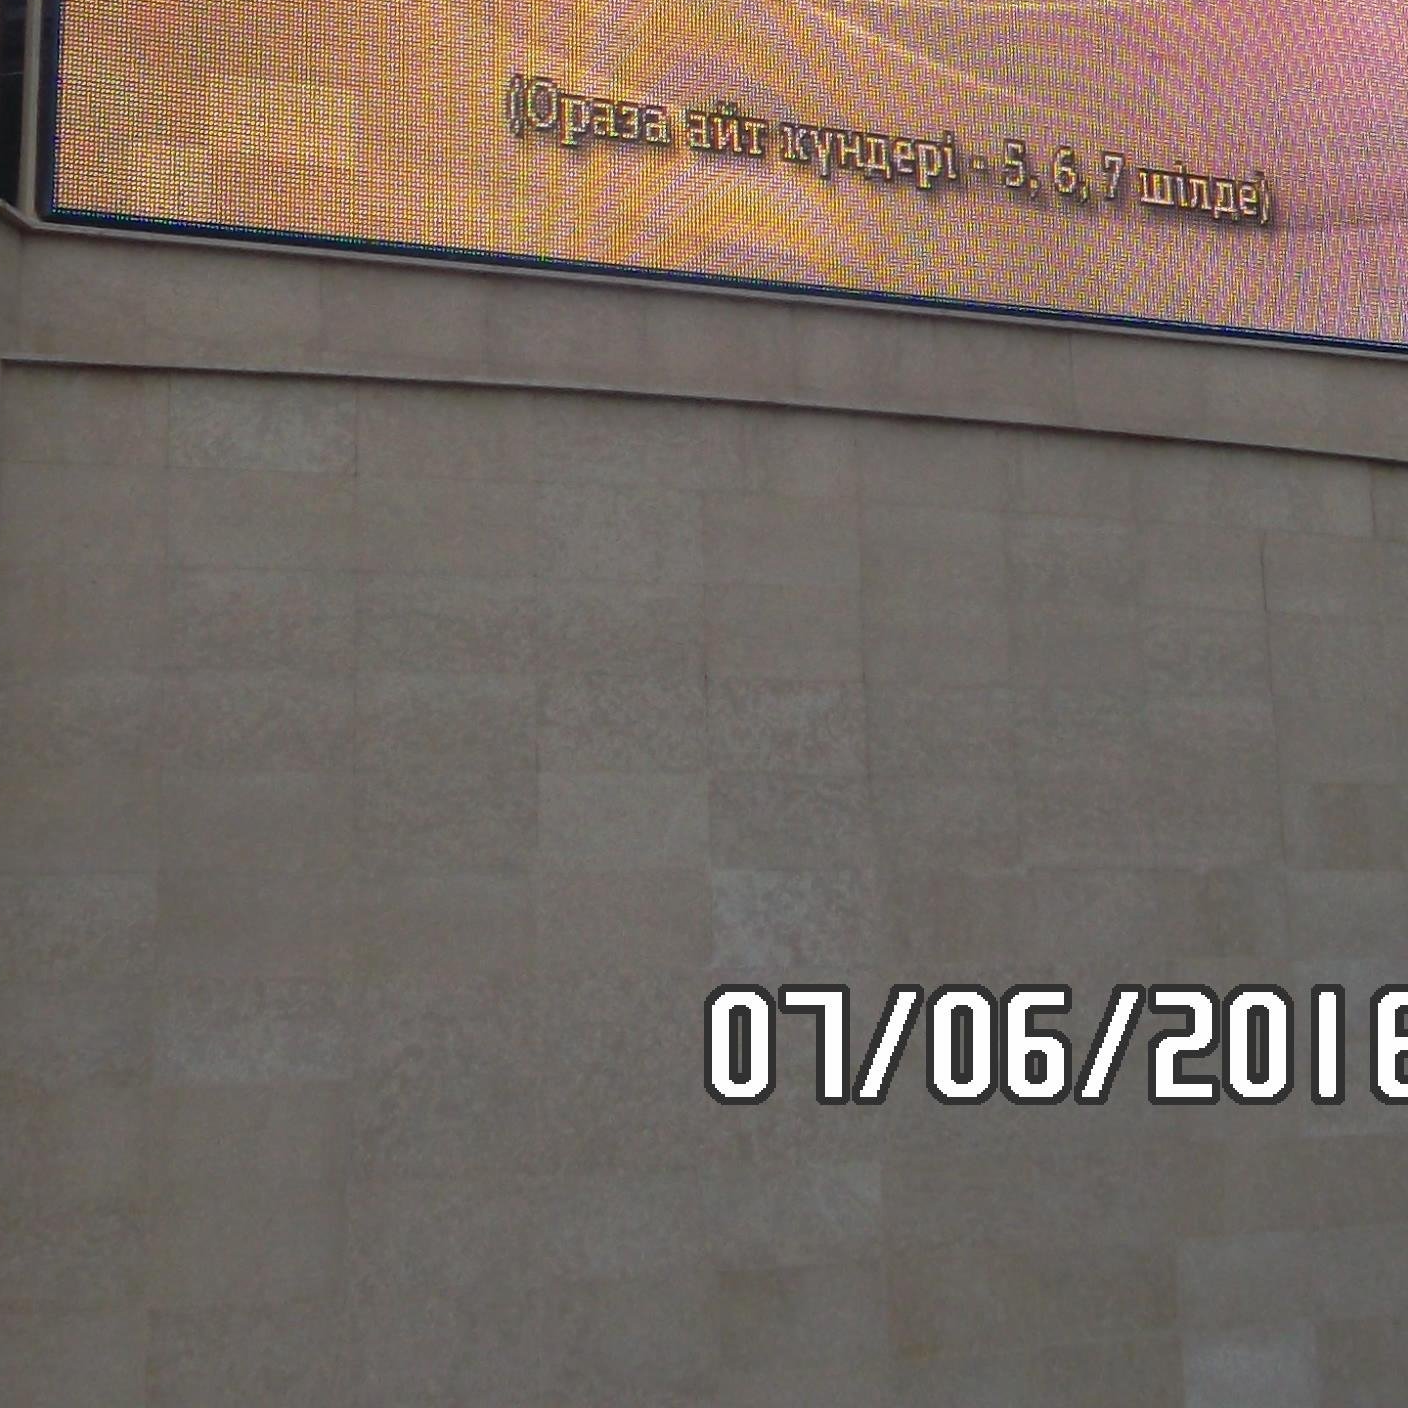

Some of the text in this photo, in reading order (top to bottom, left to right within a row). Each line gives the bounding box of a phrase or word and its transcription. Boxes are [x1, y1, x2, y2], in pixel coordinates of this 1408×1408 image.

[508, 72, 671, 148] (Ораза
[687, 101, 768, 157] айт
[781, 122, 959, 190] күндері
[1003, 139, 1039, 199] 5,
[1053, 146, 1090, 203] 6,
[1101, 151, 1126, 200] 7
[1138, 161, 1274, 225] шілде)
